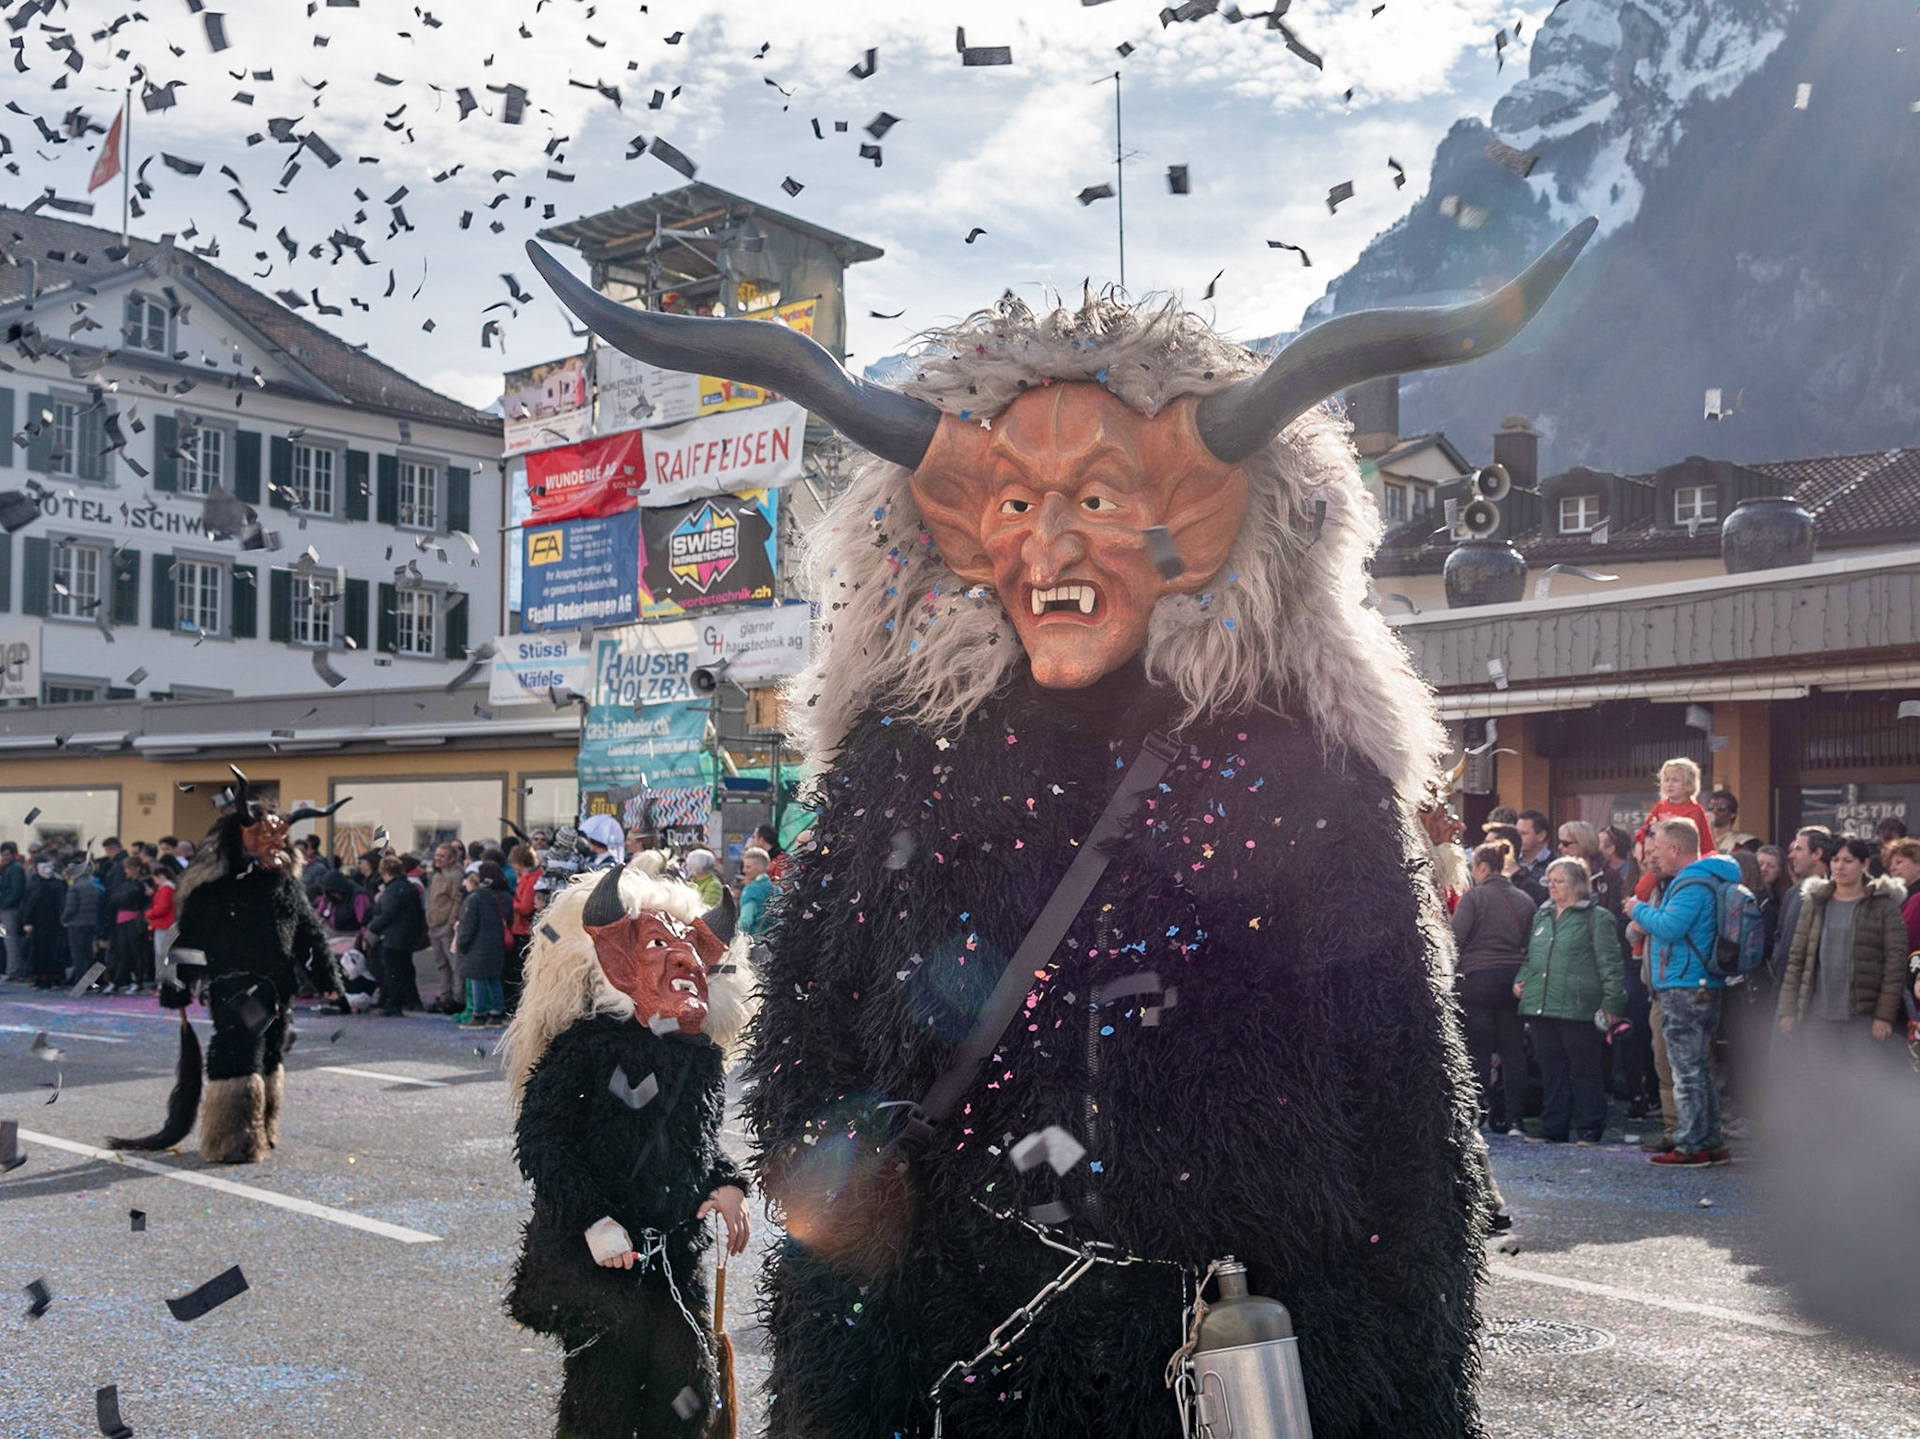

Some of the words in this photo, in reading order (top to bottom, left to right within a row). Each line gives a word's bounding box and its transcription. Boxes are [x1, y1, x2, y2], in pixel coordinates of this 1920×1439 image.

[654, 427, 790, 485] RAIFFEISEN
[30, 492, 112, 524] OTEL
[131, 506, 203, 534] SCHW
[673, 527, 735, 556] SWISS
[740, 621, 774, 638] glarner
[519, 641, 567, 659] Stüssi
[725, 637, 784, 653] haustechnik
[787, 636, 803, 650] ag
[518, 670, 564, 688] Näfels
[606, 652, 690, 682] HAUSER
[608, 676, 690, 706] HOLZBA
[667, 827, 701, 848] Druck
